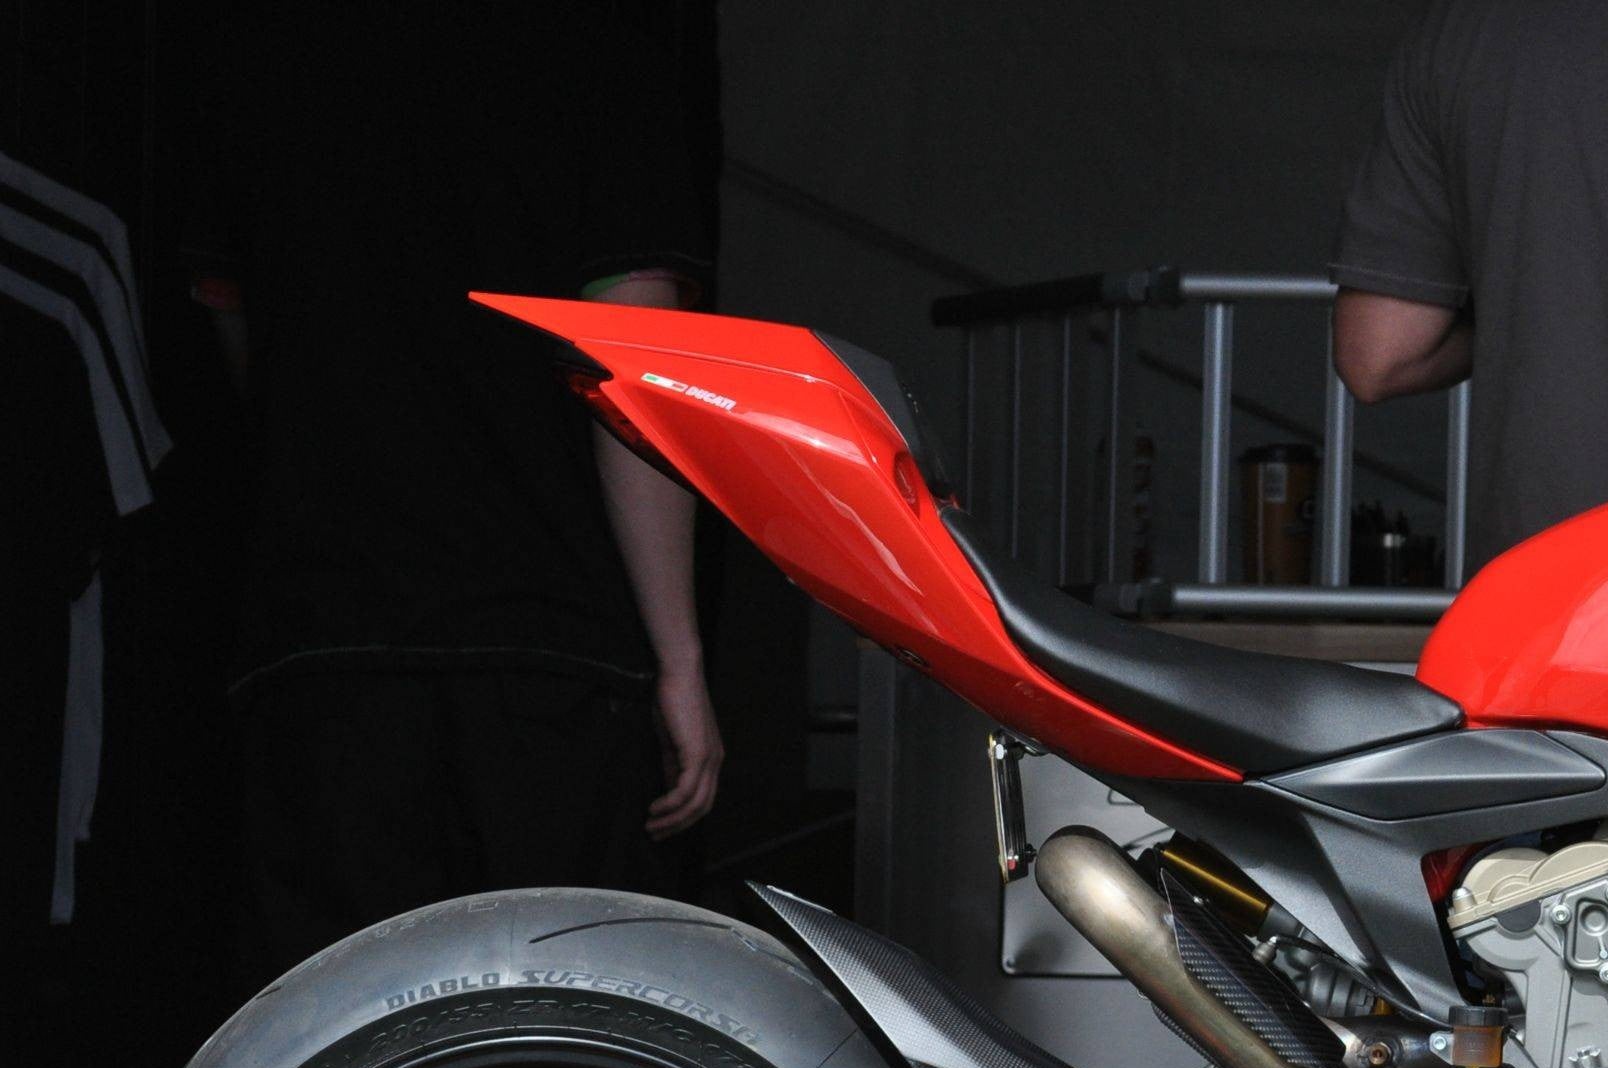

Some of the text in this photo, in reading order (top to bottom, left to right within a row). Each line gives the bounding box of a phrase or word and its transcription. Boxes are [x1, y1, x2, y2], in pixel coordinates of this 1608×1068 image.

[685, 386, 736, 410] DUCATI
[386, 969, 762, 1045] DIABLO SUPERCORSA
